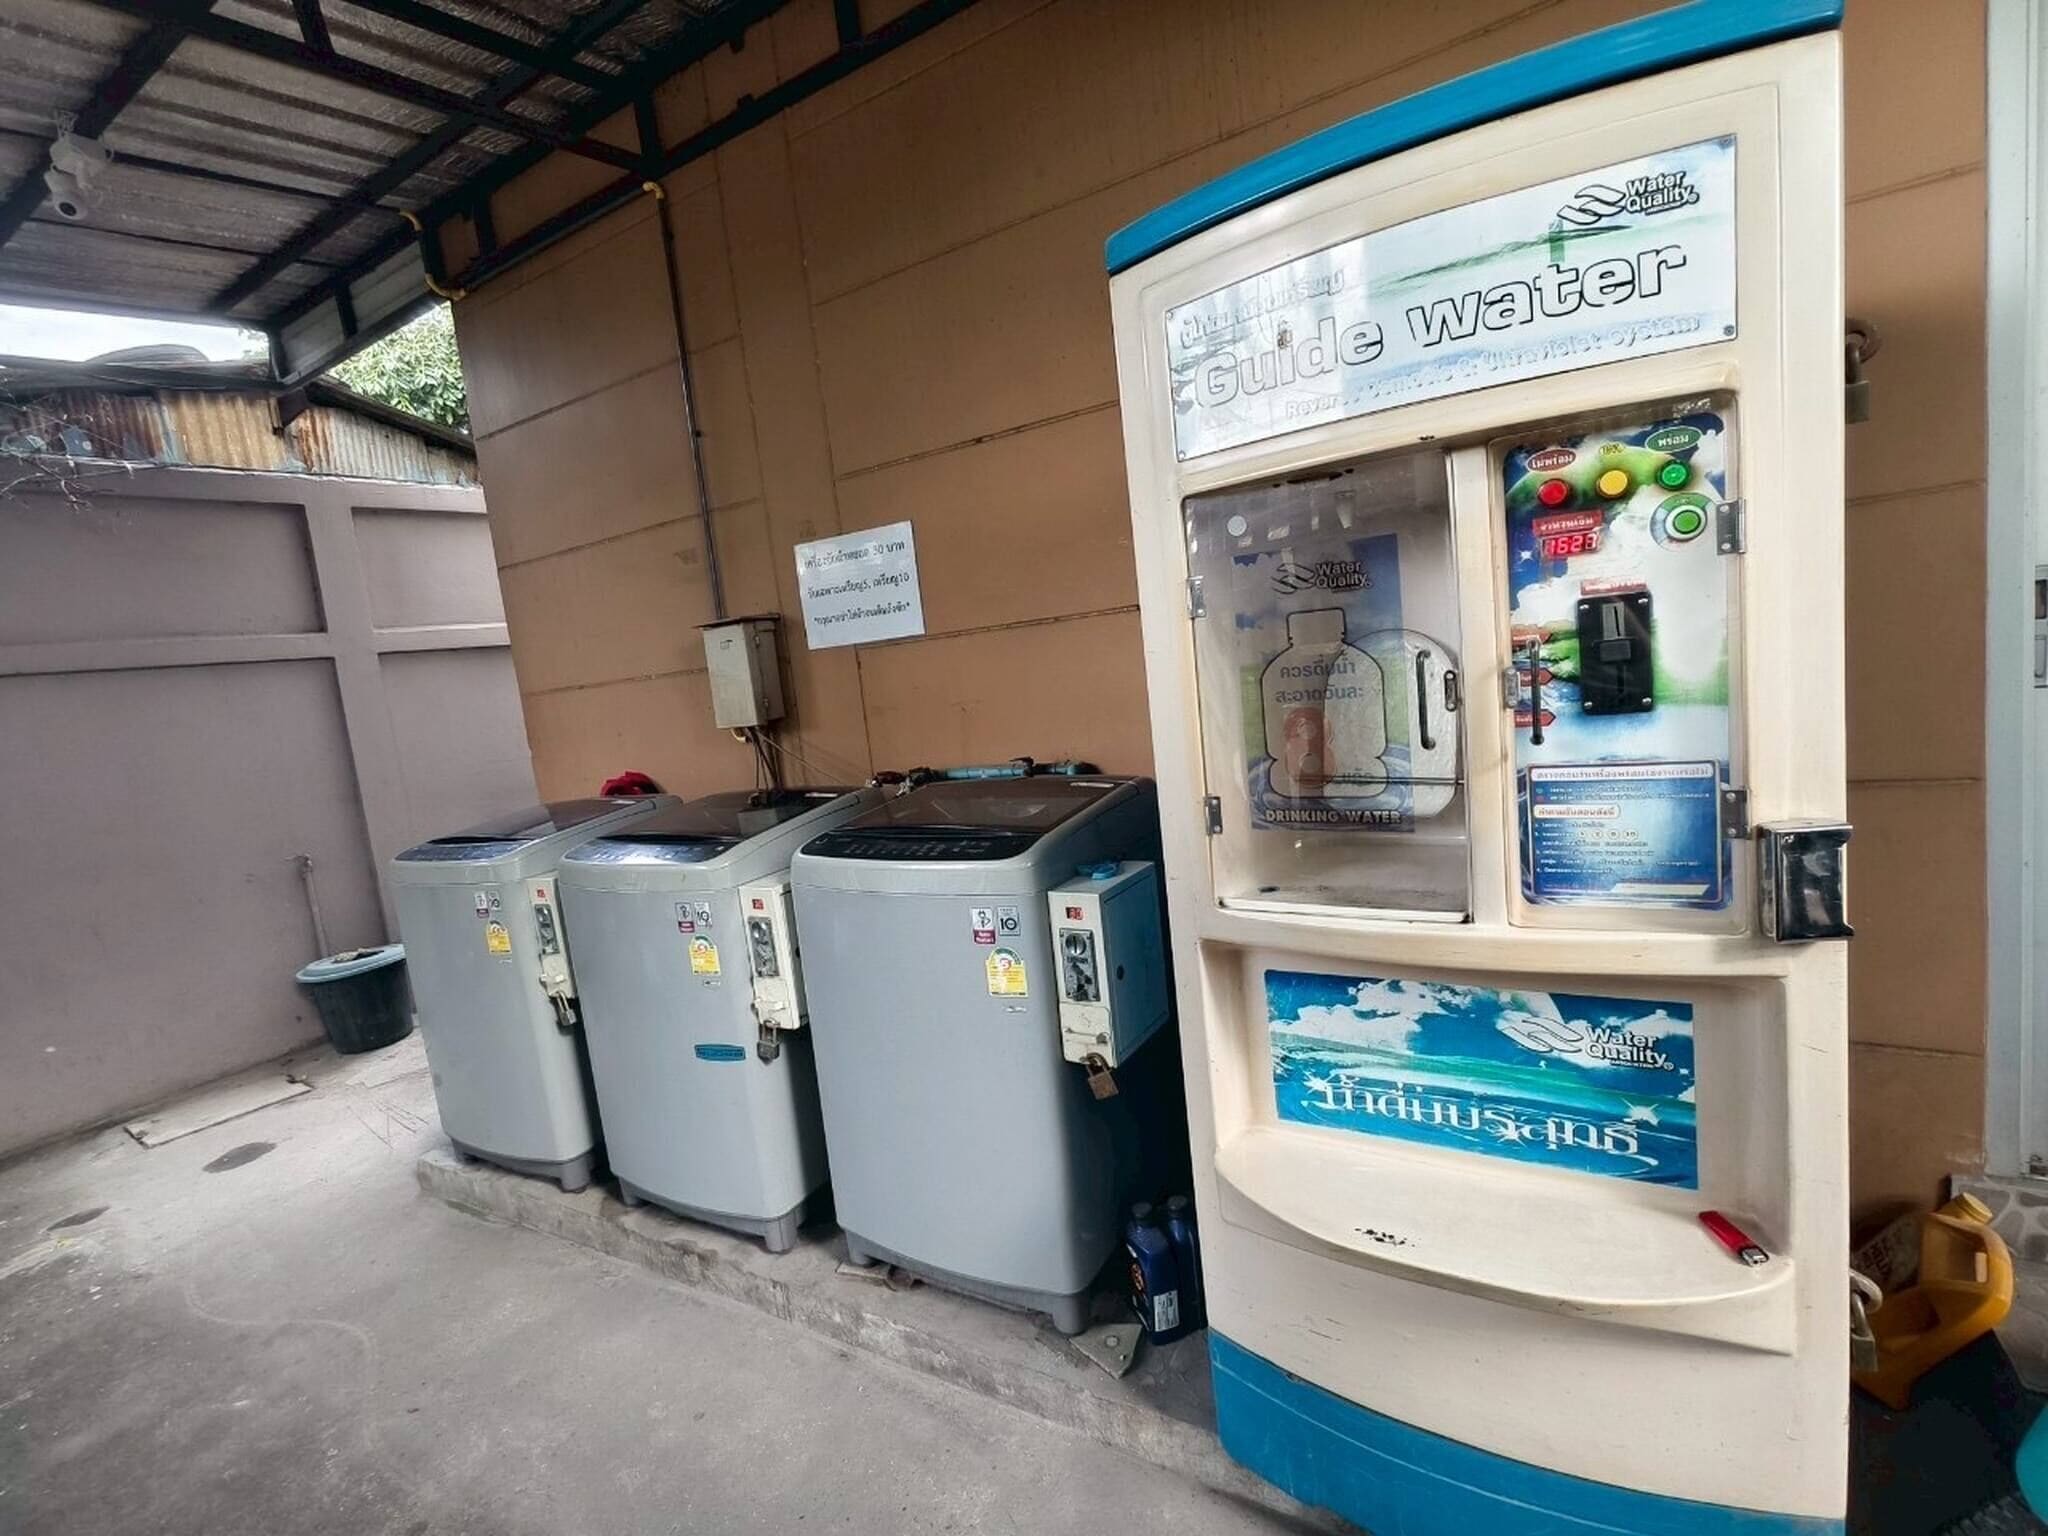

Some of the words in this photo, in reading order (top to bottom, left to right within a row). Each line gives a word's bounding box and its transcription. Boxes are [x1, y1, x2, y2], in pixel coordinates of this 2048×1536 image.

[1626, 171, 1686, 196] Water
[1626, 185, 1694, 213] Quality
[1195, 315, 1384, 408] Guide
[1406, 245, 1687, 347] water
[1316, 561, 1361, 576] Water
[1316, 573, 1369, 590] Quality
[1265, 808, 1338, 823] DRINKING
[1346, 810, 1402, 824] WATER
[1586, 1026, 1657, 1047] Water
[1587, 1043, 1667, 1068] Quality
